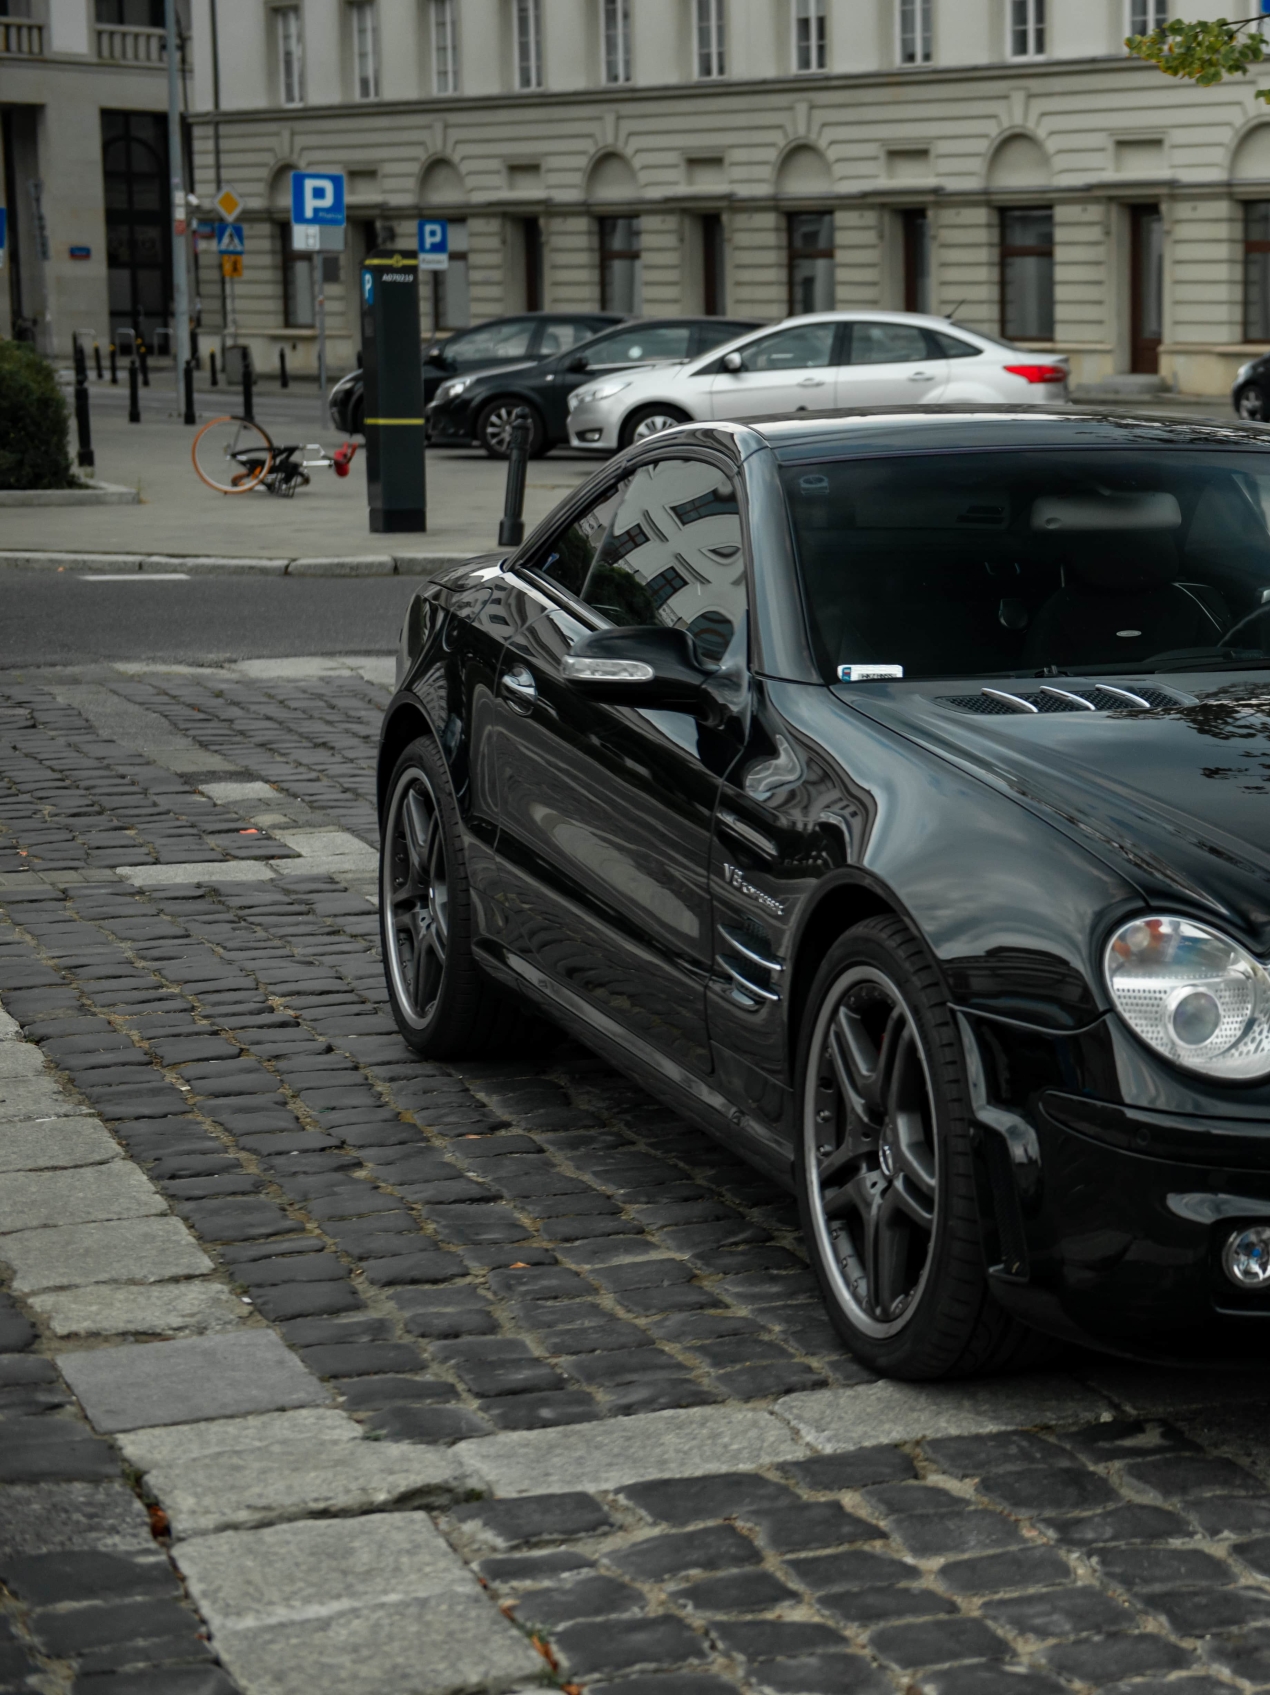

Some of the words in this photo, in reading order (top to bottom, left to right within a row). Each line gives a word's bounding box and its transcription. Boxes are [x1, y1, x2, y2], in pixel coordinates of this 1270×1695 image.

[304, 178, 334, 219] P
[424, 224, 442, 250] P
[364, 273, 373, 300] P
[382, 273, 414, 283] A070219
